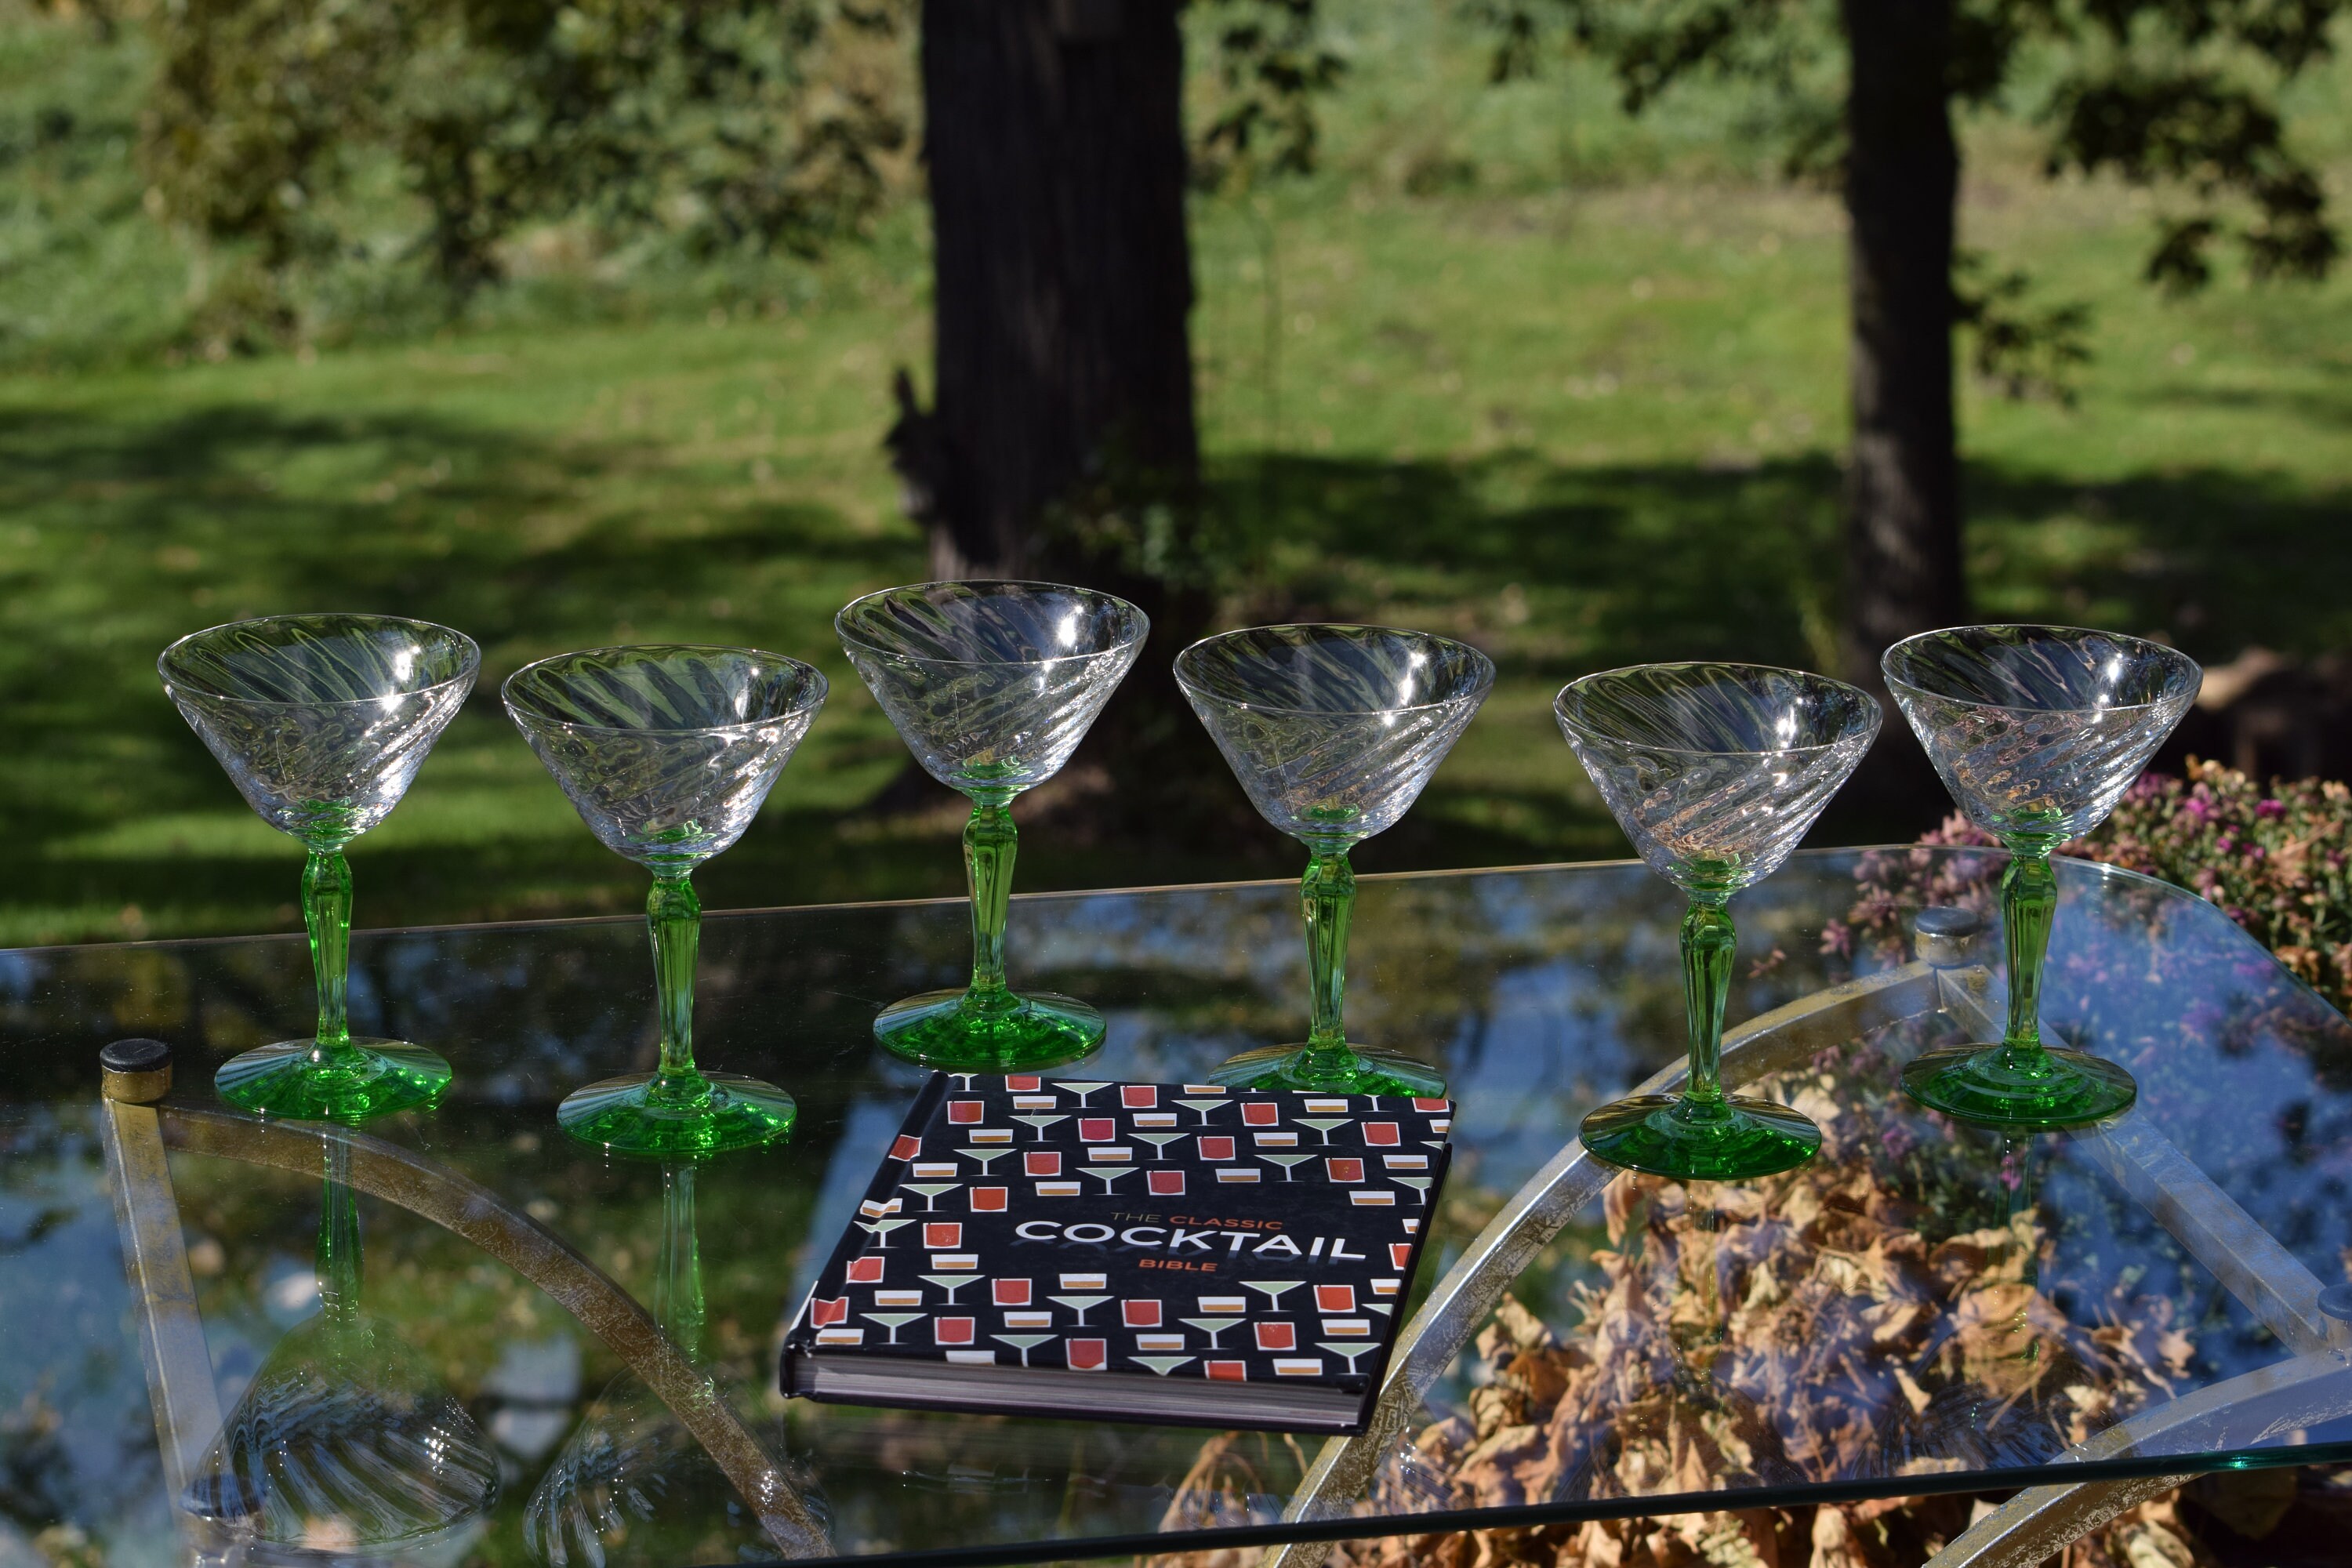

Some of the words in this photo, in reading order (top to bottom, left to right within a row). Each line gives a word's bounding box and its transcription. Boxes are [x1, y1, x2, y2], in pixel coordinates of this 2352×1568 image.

[1110, 1212, 1161, 1224] THE
[1169, 1215, 1283, 1230] CLASSIC
[1014, 1221, 1367, 1259] COCKTAIL
[1138, 1258, 1218, 1272] BIBLE
